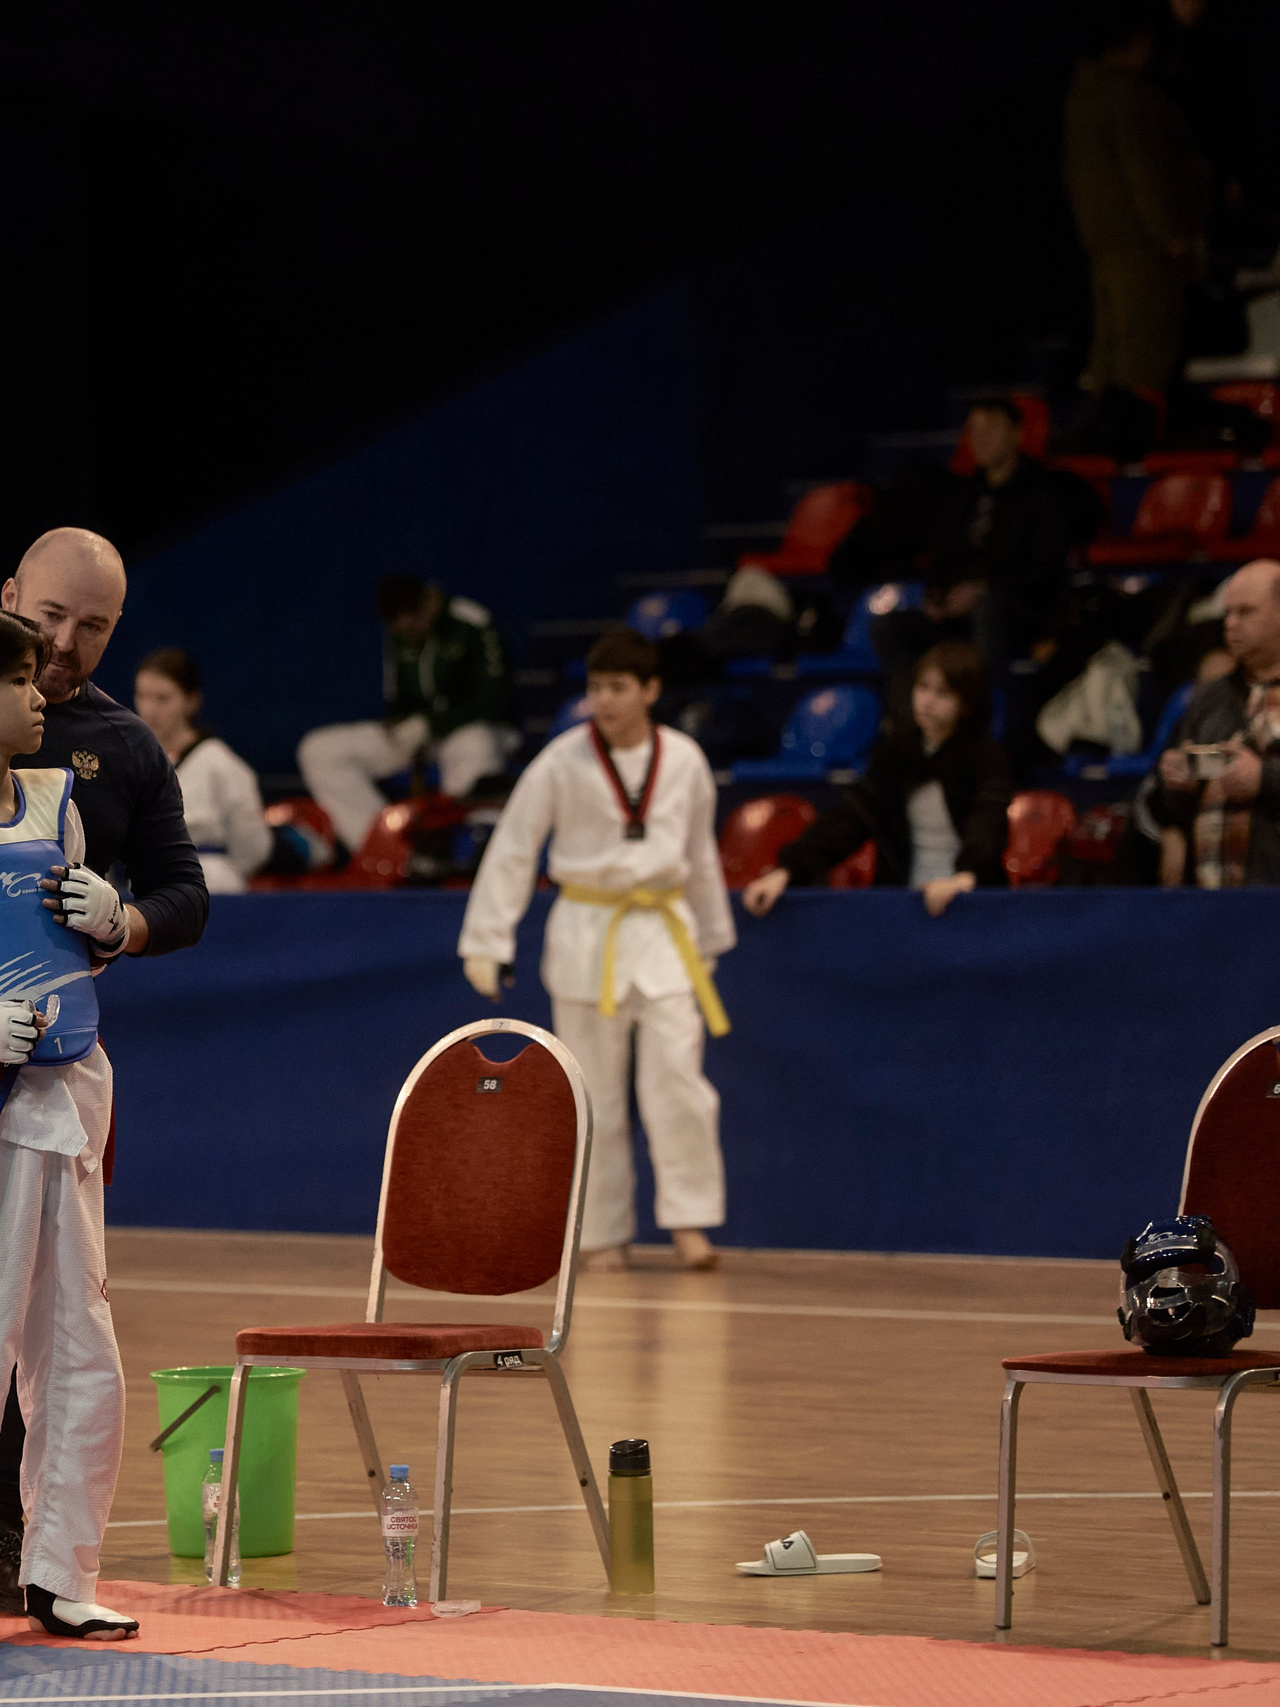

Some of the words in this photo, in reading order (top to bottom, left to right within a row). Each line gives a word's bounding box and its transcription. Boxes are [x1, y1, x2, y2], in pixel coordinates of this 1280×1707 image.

[53, 1037, 63, 1055] 1
[483, 1080, 497, 1090] 58
[497, 1354, 504, 1366] 4
